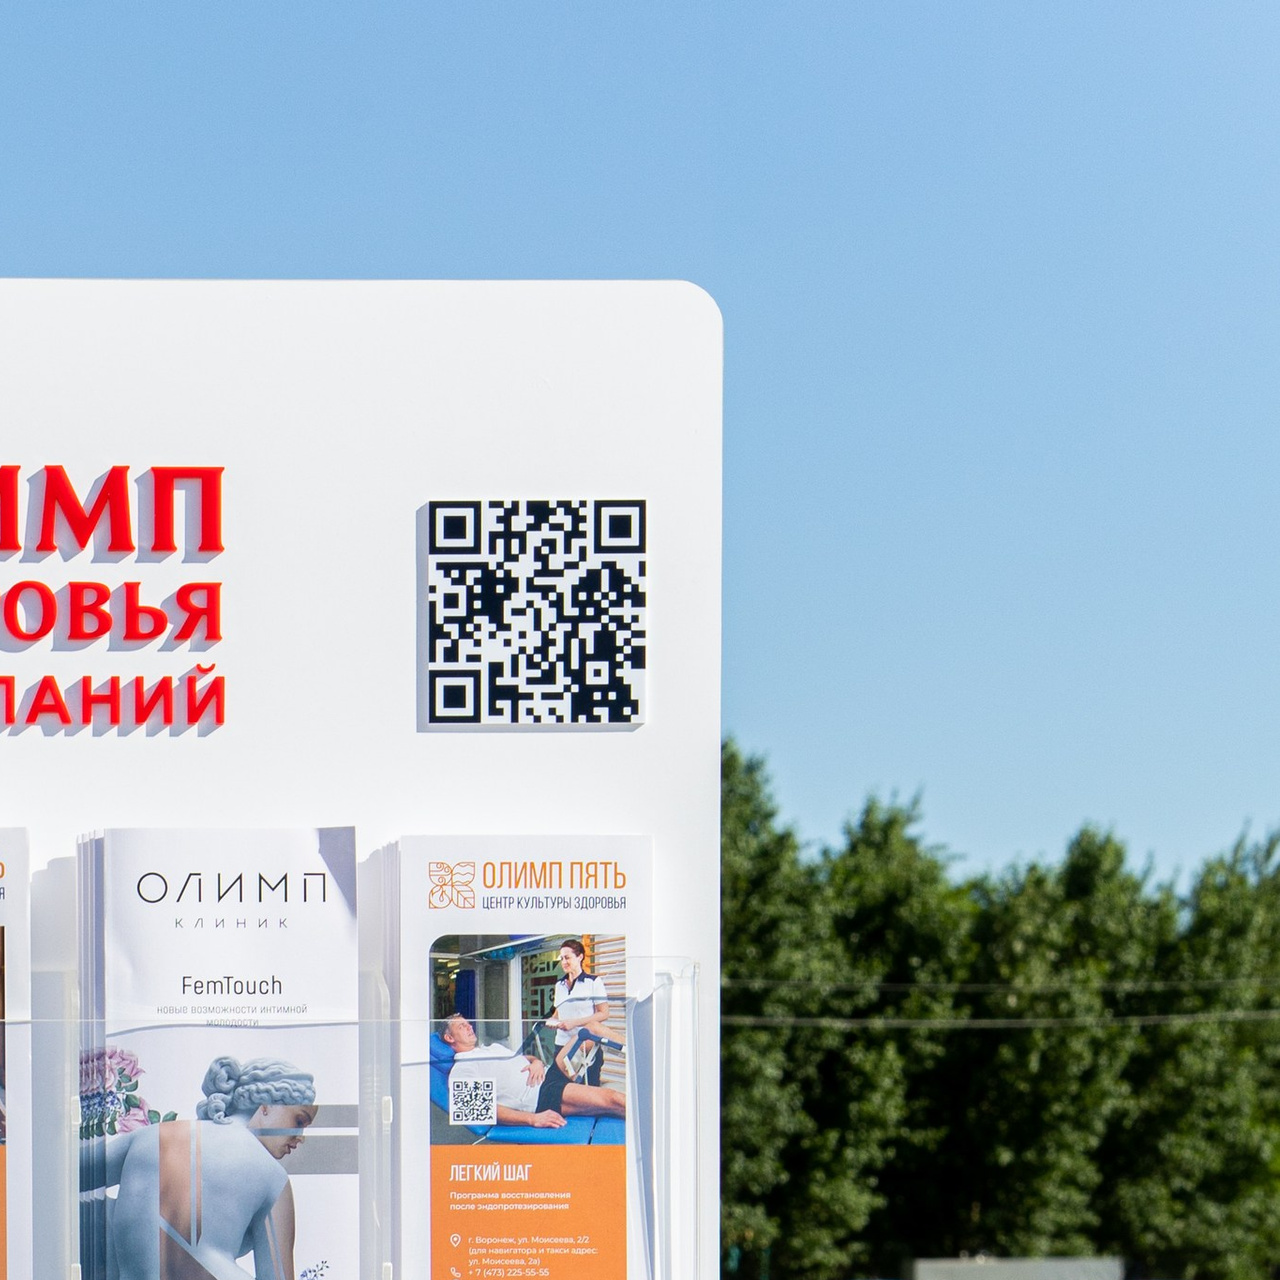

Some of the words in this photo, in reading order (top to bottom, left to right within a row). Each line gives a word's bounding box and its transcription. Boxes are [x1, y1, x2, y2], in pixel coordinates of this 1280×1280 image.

[483, 862, 562, 889] ОЛИМП
[569, 862, 626, 888] ПЯТЬ
[137, 872, 326, 903] ОЛИМП
[175, 918, 288, 929] КЛИНИК
[182, 975, 283, 995] FemTouch
[449, 1162, 500, 1182] ЛЕГКИЙ
[504, 1164, 532, 1181] ШАГ
[450, 1191, 499, 1200] Программа
[478, 1202, 569, 1211] эндопротезирования
